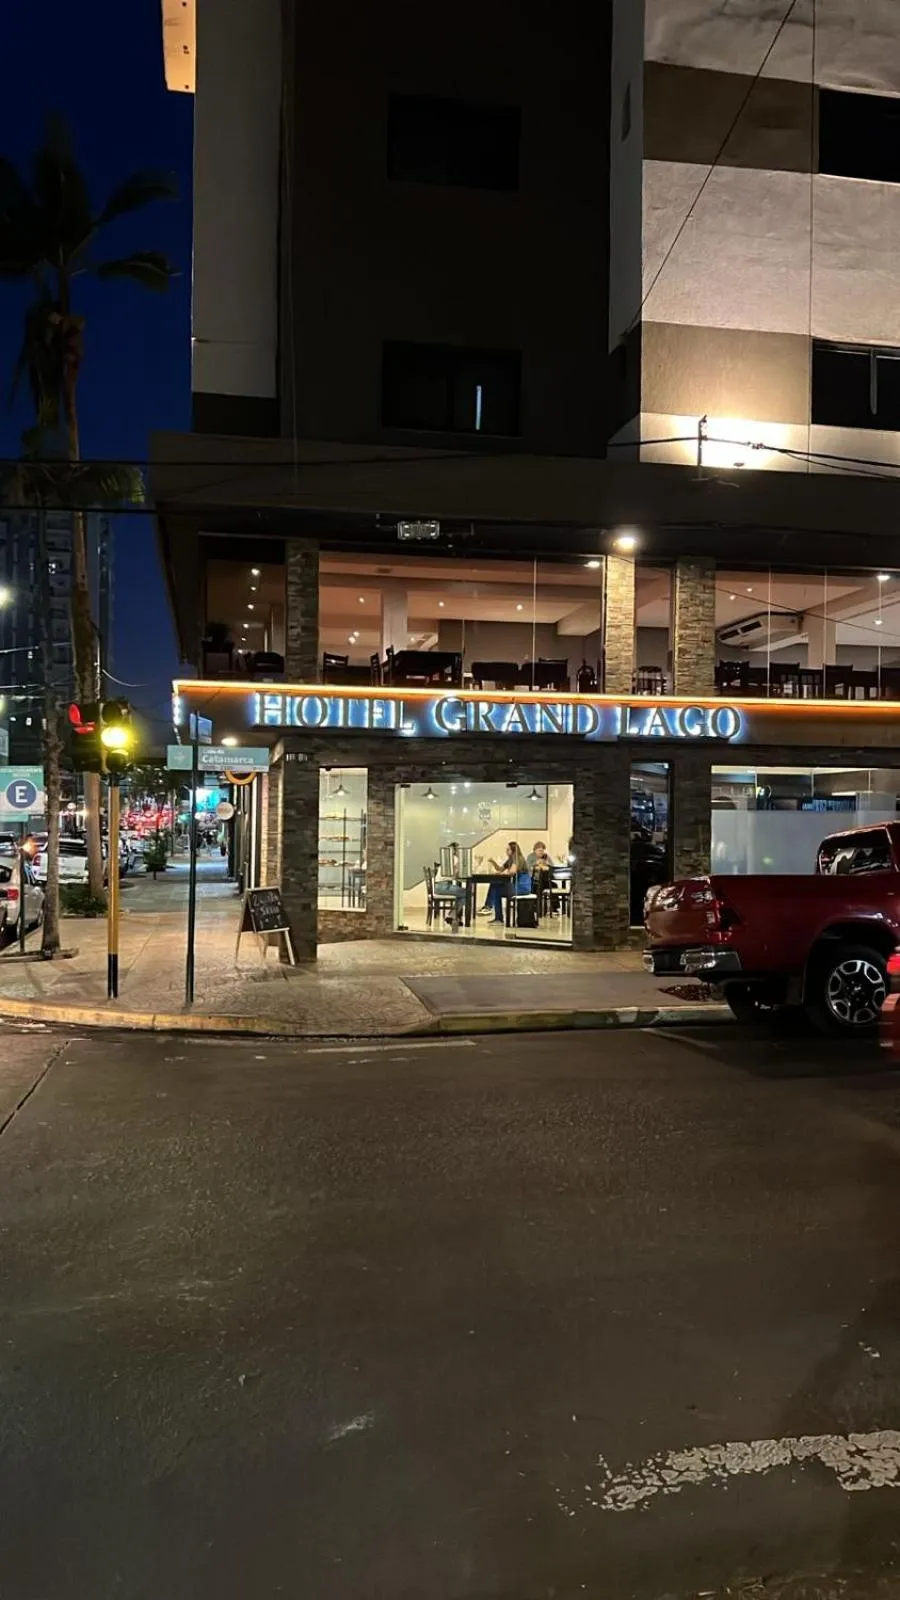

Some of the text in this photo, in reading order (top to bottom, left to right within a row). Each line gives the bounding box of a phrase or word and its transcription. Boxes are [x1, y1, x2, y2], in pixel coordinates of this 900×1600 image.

[433, 696, 600, 736] GRAND
[616, 703, 742, 738] LAGO
[202, 754, 255, 765] Catamarca
[15, 785, 28, 803] E
